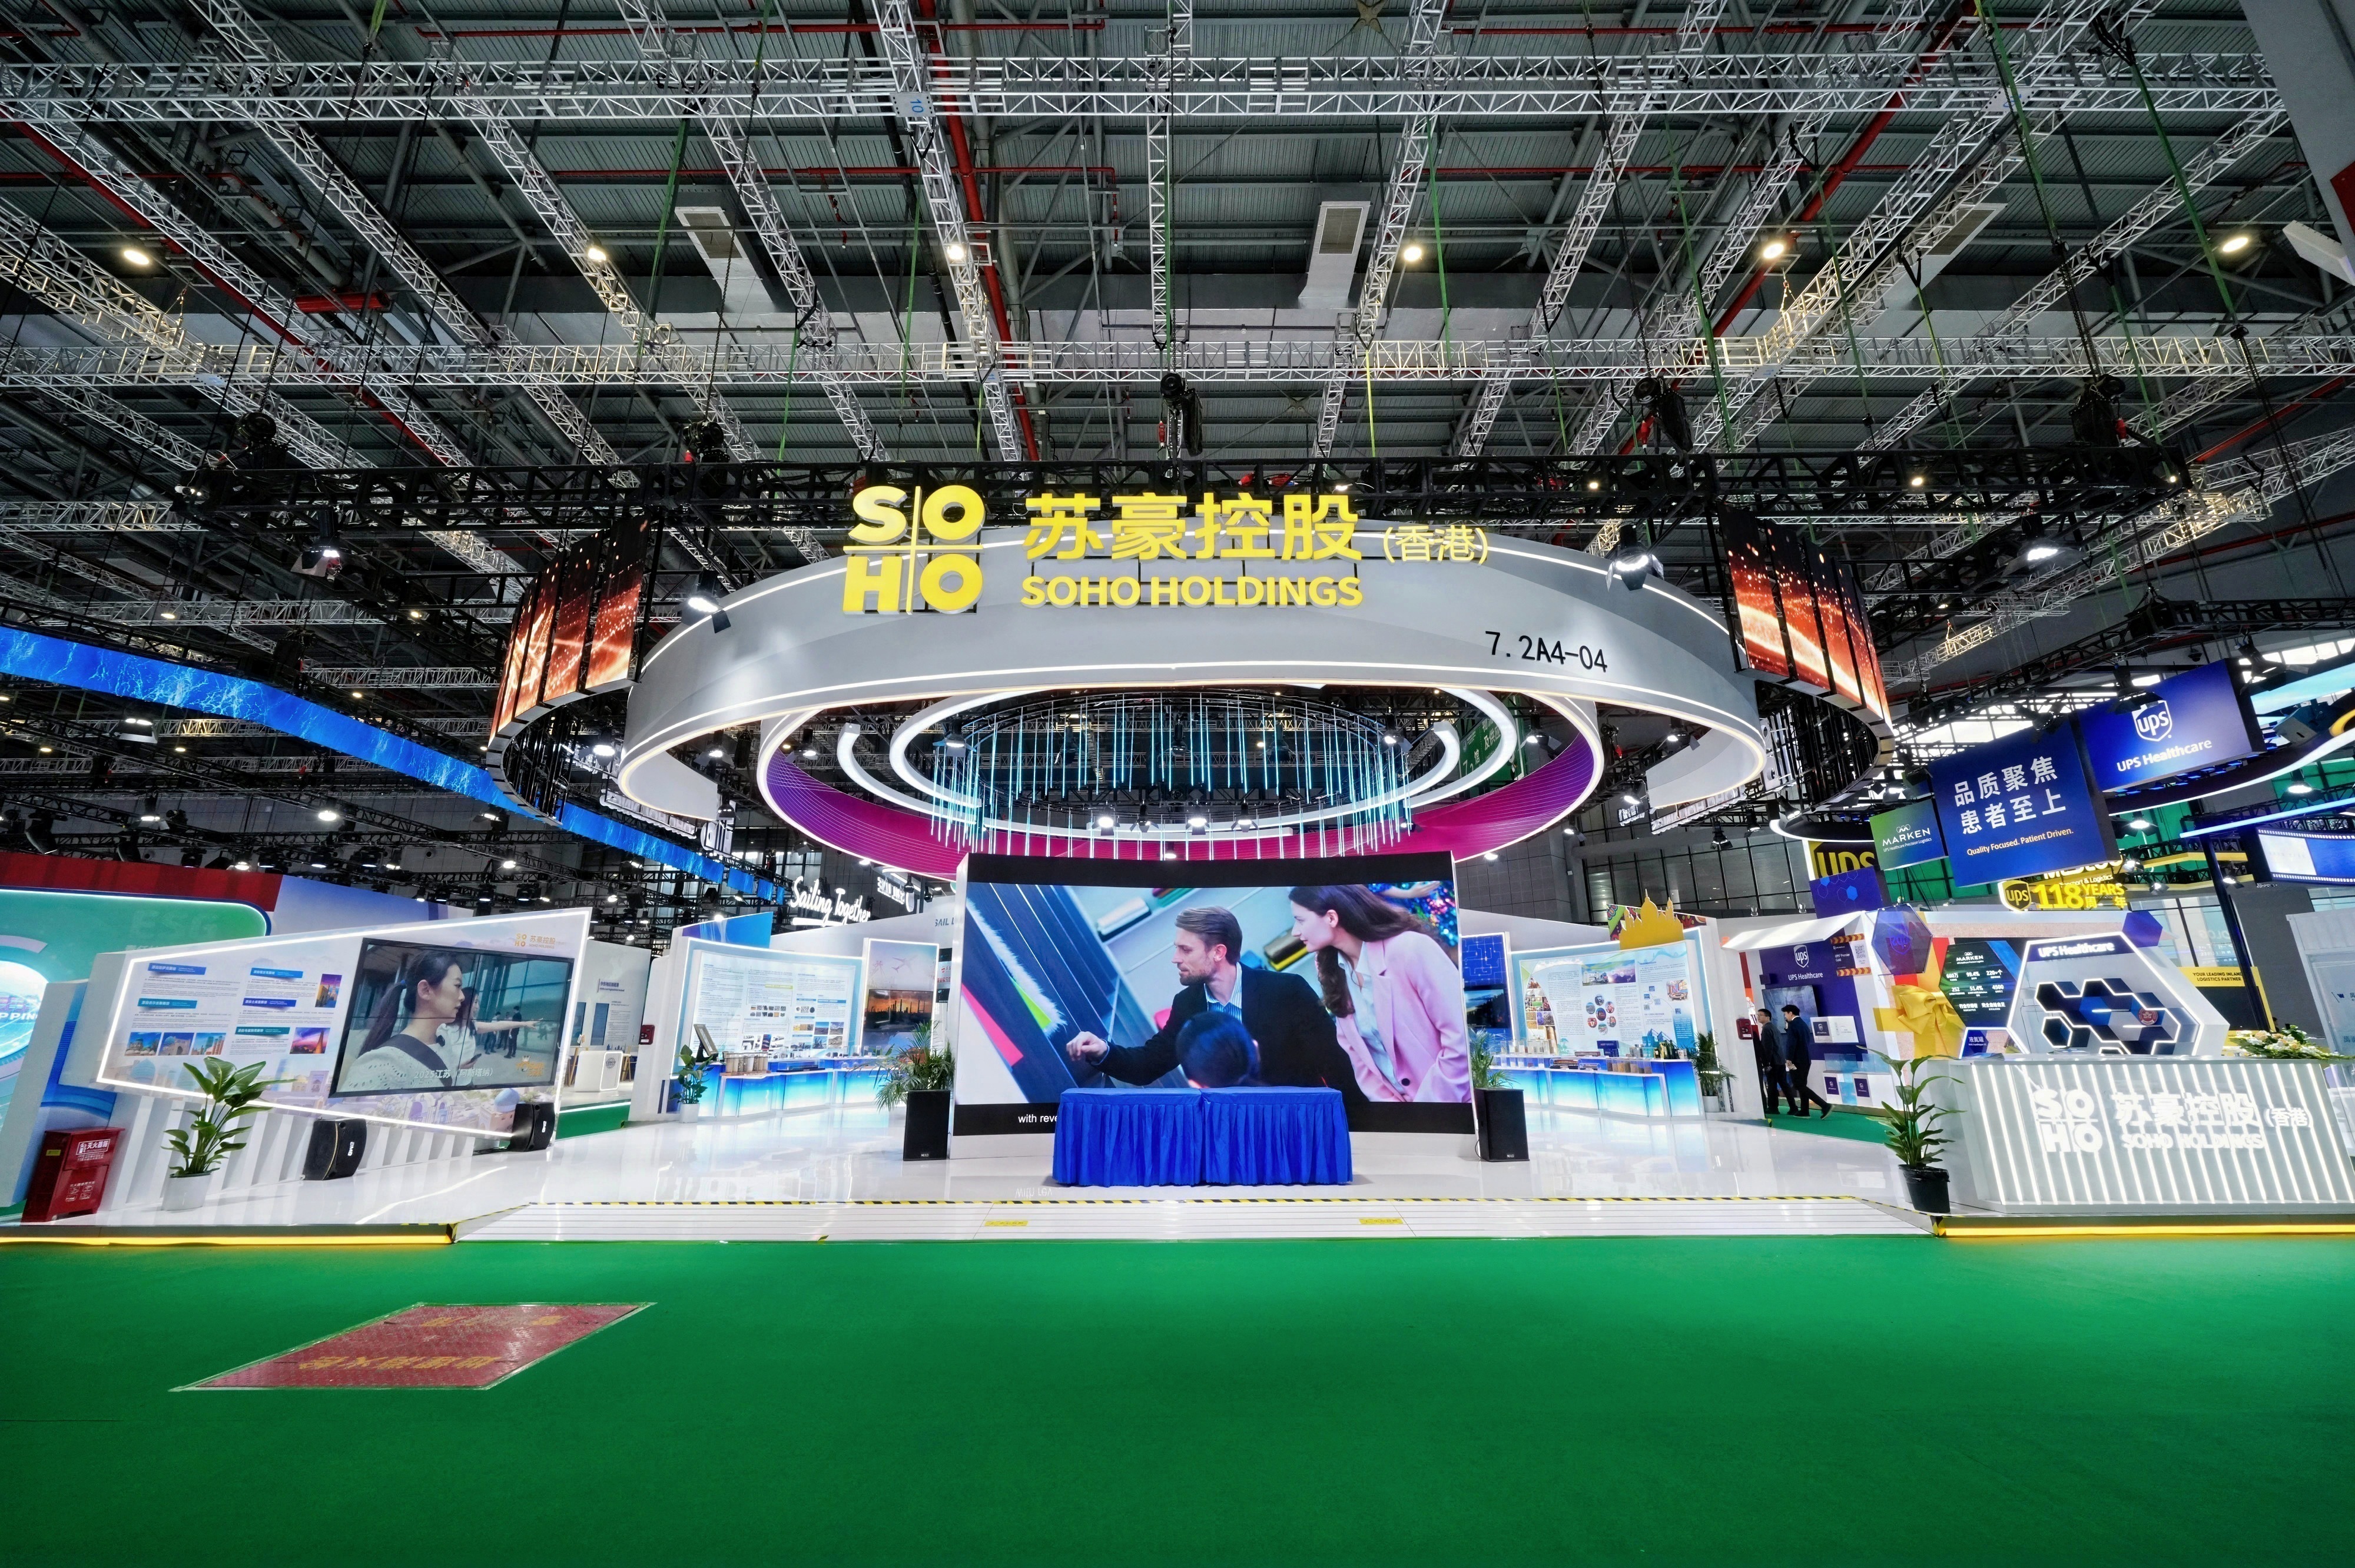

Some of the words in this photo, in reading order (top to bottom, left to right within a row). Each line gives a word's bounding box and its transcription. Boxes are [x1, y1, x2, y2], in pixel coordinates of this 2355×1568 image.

[910, 99, 924, 112] 10
[1021, 492, 1362, 563] 苏豪控股
[1382, 523, 1488, 564] (香港)
[1021, 575, 1142, 609] SOHO
[1150, 574, 1364, 609] HOLDINGS
[2137, 710, 2170, 736] ups
[2117, 757, 2141, 772] UPS
[2142, 738, 2213, 765] Healthcare
[1954, 756, 2058, 807] 品质聚焦
[1961, 788, 2067, 835] 患者至上
[1883, 828, 1931, 846] MARKEN
[1966, 845, 1991, 856] Quality
[1991, 839, 2020, 851] Focused.
[2021, 832, 2046, 844] Patient
[2046, 828, 2074, 839] Driven.
[2089, 875, 2114, 883] Logistics
[790, 876, 832, 927] Sailing
[834, 888, 871, 926] Together
[2006, 889, 2030, 906] ups
[2032, 884, 2085, 909] 118
[2081, 883, 2125, 895] YEARS
[530, 935, 556, 945] 苏豪控股
[2038, 946, 2059, 958] UPS
[2059, 943, 2115, 955] Healthcare
[1796, 951, 1807, 964] ups
[1798, 972, 1823, 980] Healthcare
[1018, 1114, 1037, 1123] with
[2111, 1092, 2257, 1128] 苏豪控股
[2121, 1132, 2174, 1150] SOHO
[2178, 1132, 2266, 1150] HOLDINGS
